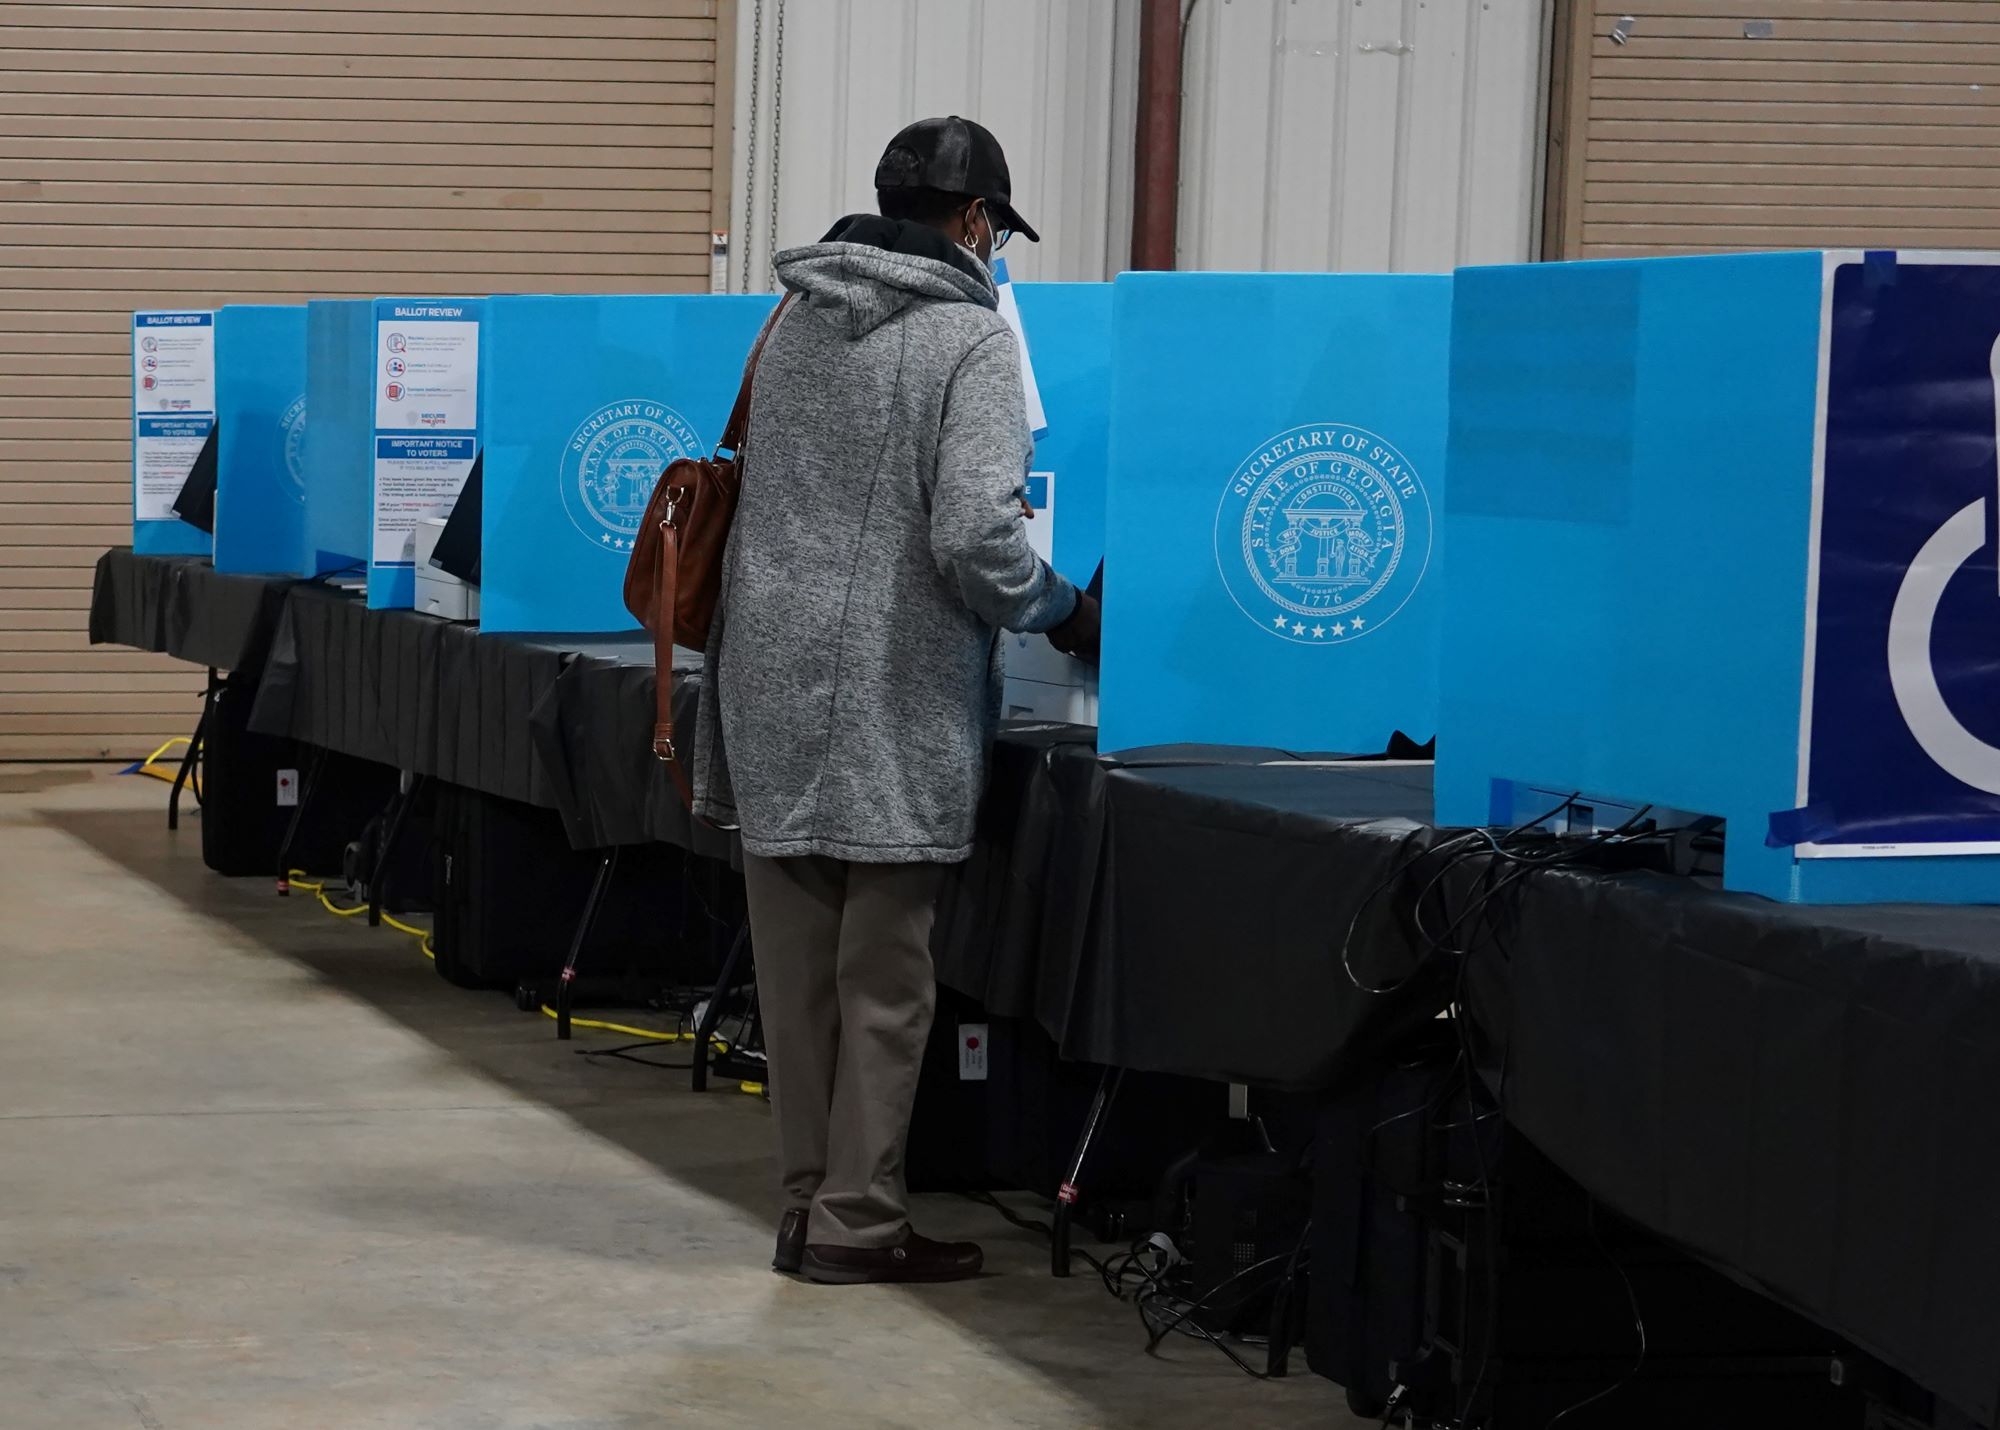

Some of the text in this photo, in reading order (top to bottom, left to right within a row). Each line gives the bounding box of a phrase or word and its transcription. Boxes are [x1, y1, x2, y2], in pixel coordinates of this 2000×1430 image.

[394, 307, 463, 316] BALLOT REVIEW
[173, 316, 201, 324] REVIEW
[573, 404, 697, 452] SECRETARY OF STATE
[391, 440, 462, 448] IMPORTANT NOTICE
[418, 449, 448, 457] VOTERS
[585, 437, 610, 487] STATE
[613, 426, 630, 438] OF
[1234, 431, 1417, 499] SECRETARY OF STATE
[1296, 485, 1357, 506] CONSTITUTION
[1252, 461, 1394, 549] STATE OF GEORGIA
[620, 518, 640, 527] 177
[1310, 528, 1338, 537] JUSTICE
[1349, 545, 1369, 558] ATION
[1301, 593, 1342, 606] 1776
